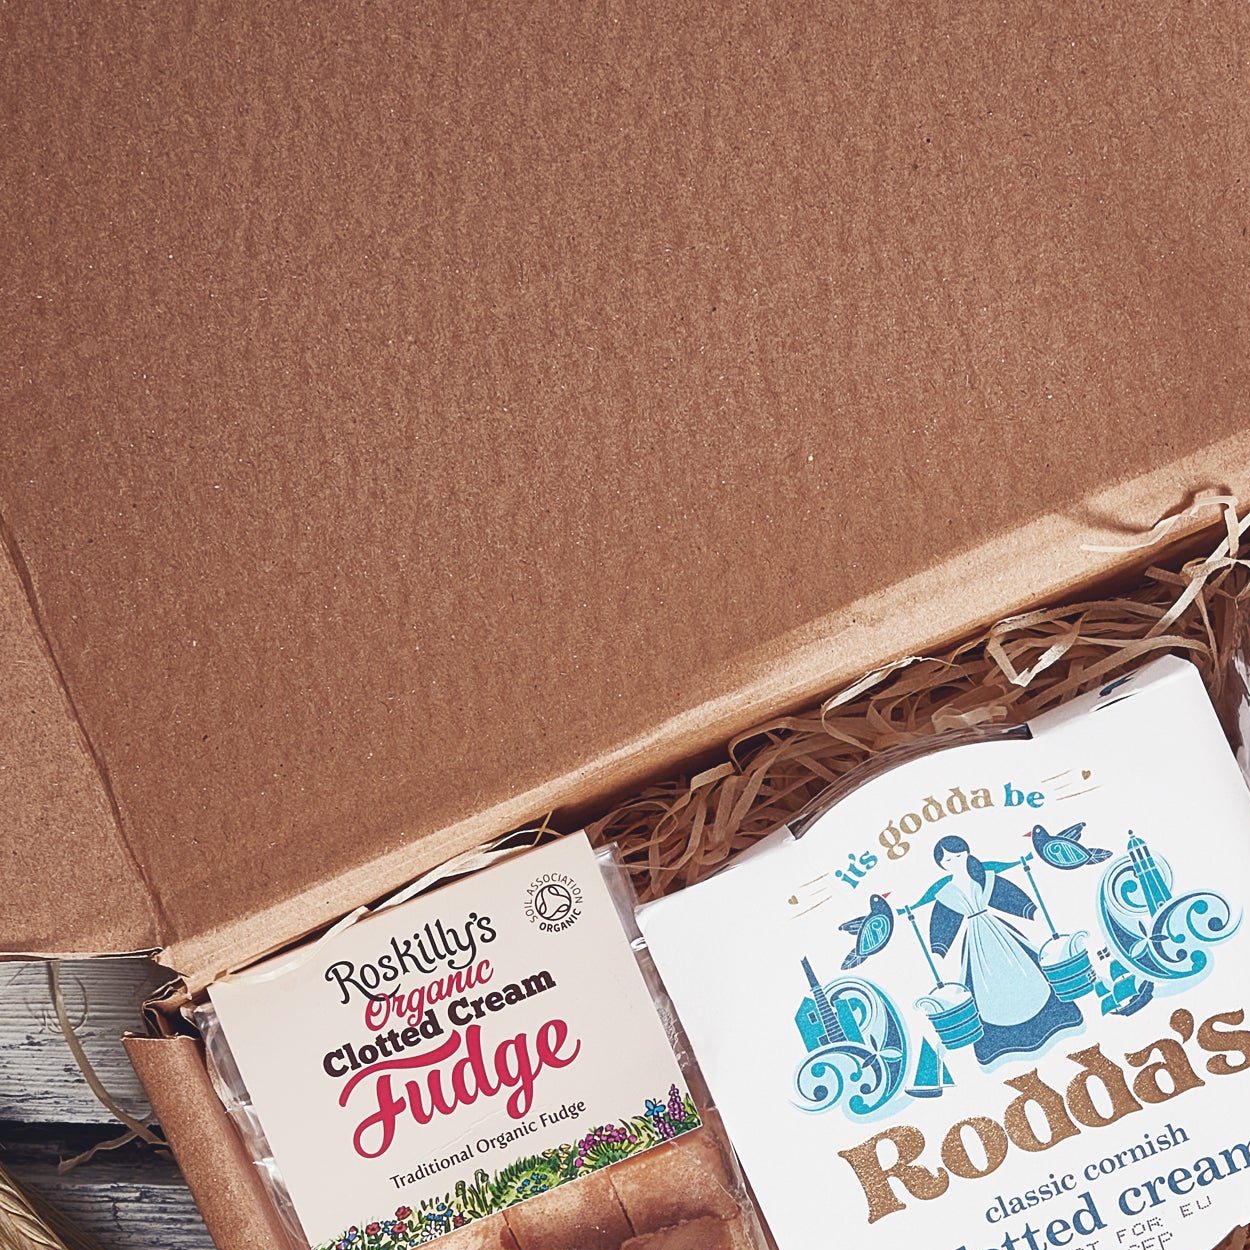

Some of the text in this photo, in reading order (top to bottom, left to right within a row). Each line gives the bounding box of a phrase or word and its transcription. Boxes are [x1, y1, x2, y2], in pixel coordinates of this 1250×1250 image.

[835, 851, 879, 889] it's
[1003, 782, 1045, 809] be
[523, 872, 583, 923] SOIL ASSOCIATION
[538, 908, 582, 933] ORGANIC
[324, 912, 497, 1004] Roskilly's
[364, 959, 494, 1032] Organic
[322, 969, 557, 1078] Clotted Cream
[338, 1018, 582, 1159] Fudge
[389, 1101, 587, 1189] Traditional Organic Fudge
[984, 1123, 1191, 1225] classic cornish
[1116, 1215, 1164, 1245] FOR
[1178, 1195, 1214, 1219] EU
